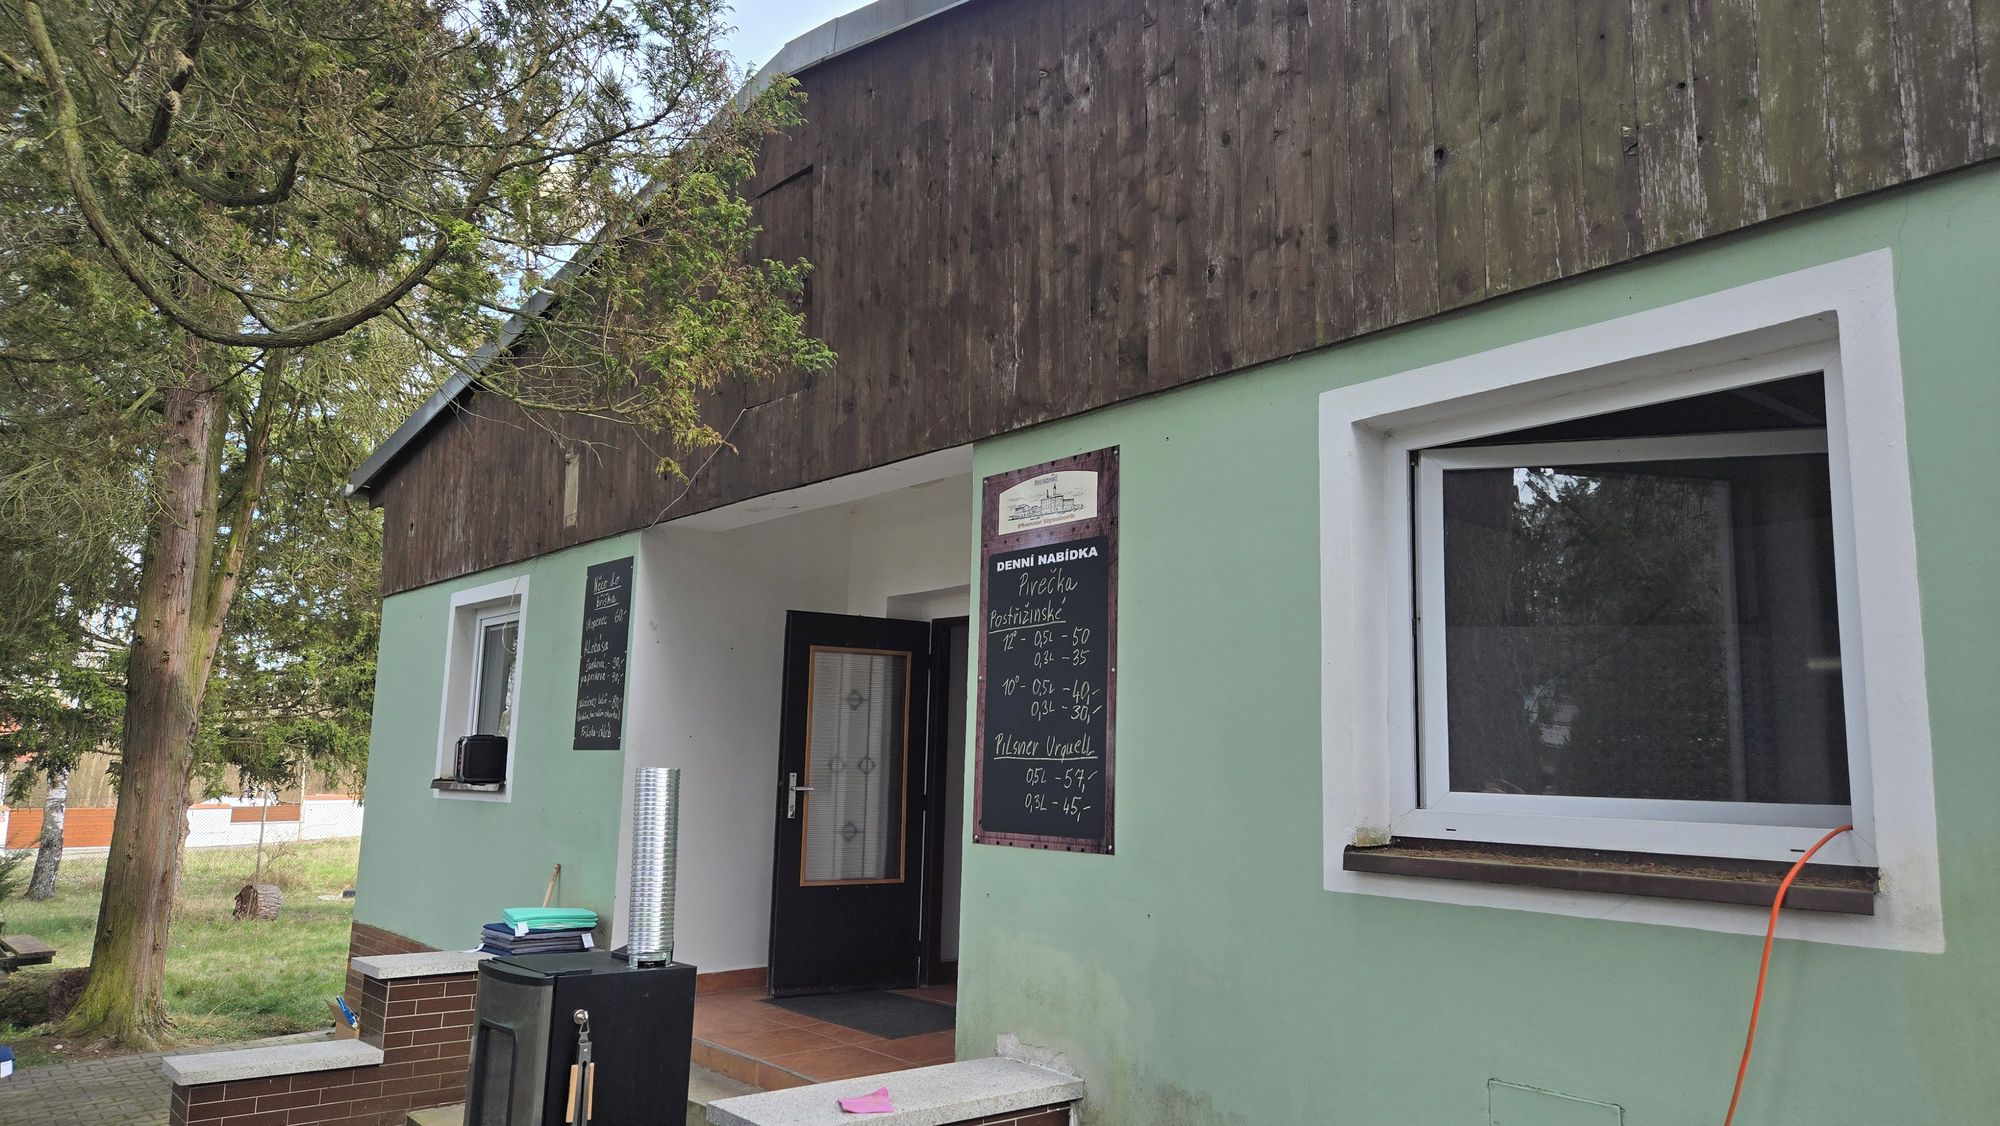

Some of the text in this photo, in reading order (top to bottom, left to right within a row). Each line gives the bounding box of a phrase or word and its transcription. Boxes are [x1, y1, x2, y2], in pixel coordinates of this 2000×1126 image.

[996, 546, 1098, 572] DENNÍ NABÍDKA
[1072, 627, 1090, 646] 50
[1072, 649, 1090, 666] 35
